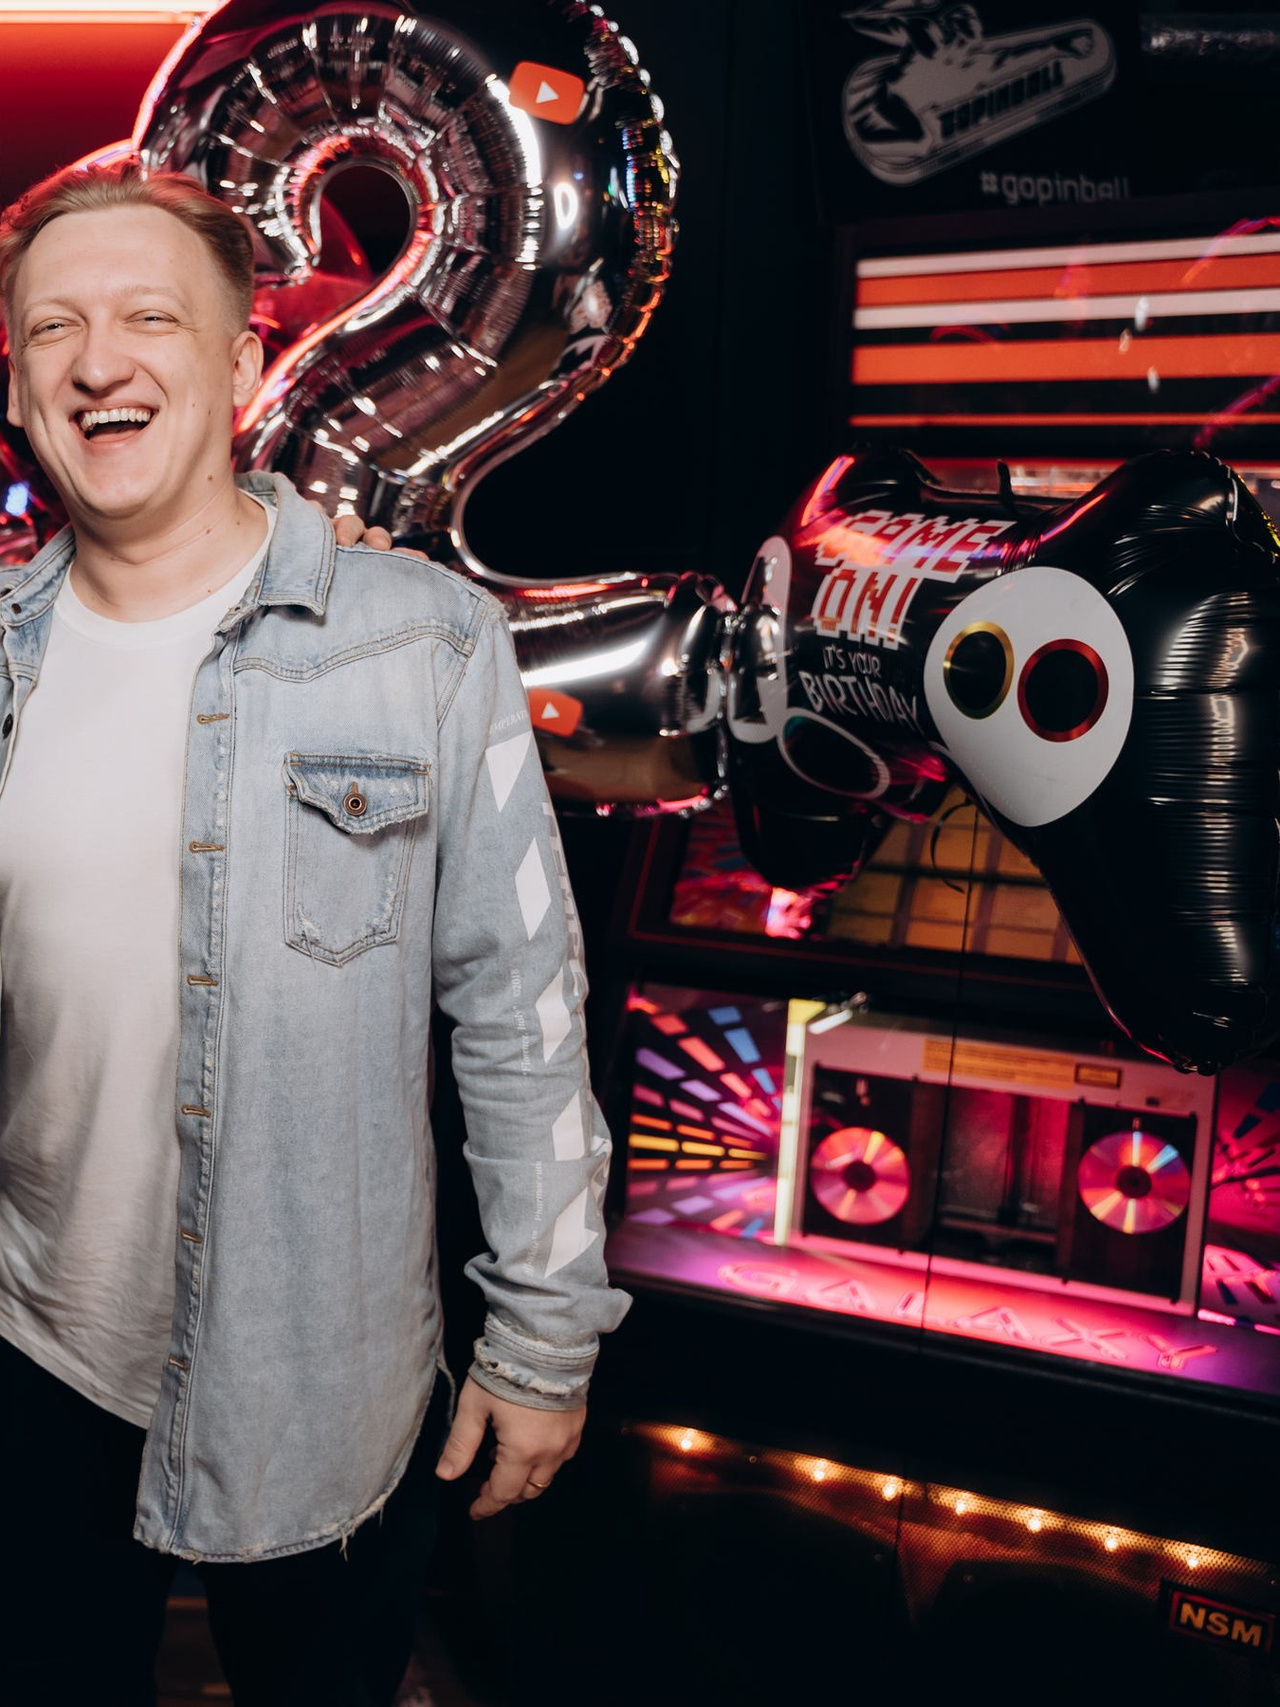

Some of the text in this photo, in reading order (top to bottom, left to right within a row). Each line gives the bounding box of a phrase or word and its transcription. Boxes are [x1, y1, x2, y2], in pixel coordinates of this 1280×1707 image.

[981, 171, 1129, 206] #gopinball
[811, 566, 924, 651] ON!
[822, 644, 883, 678] IT'S YOUR
[798, 670, 925, 736] BIRTHDAY
[717, 1260, 1218, 1371] GALAXY
[1180, 1602, 1263, 1647] NSM
